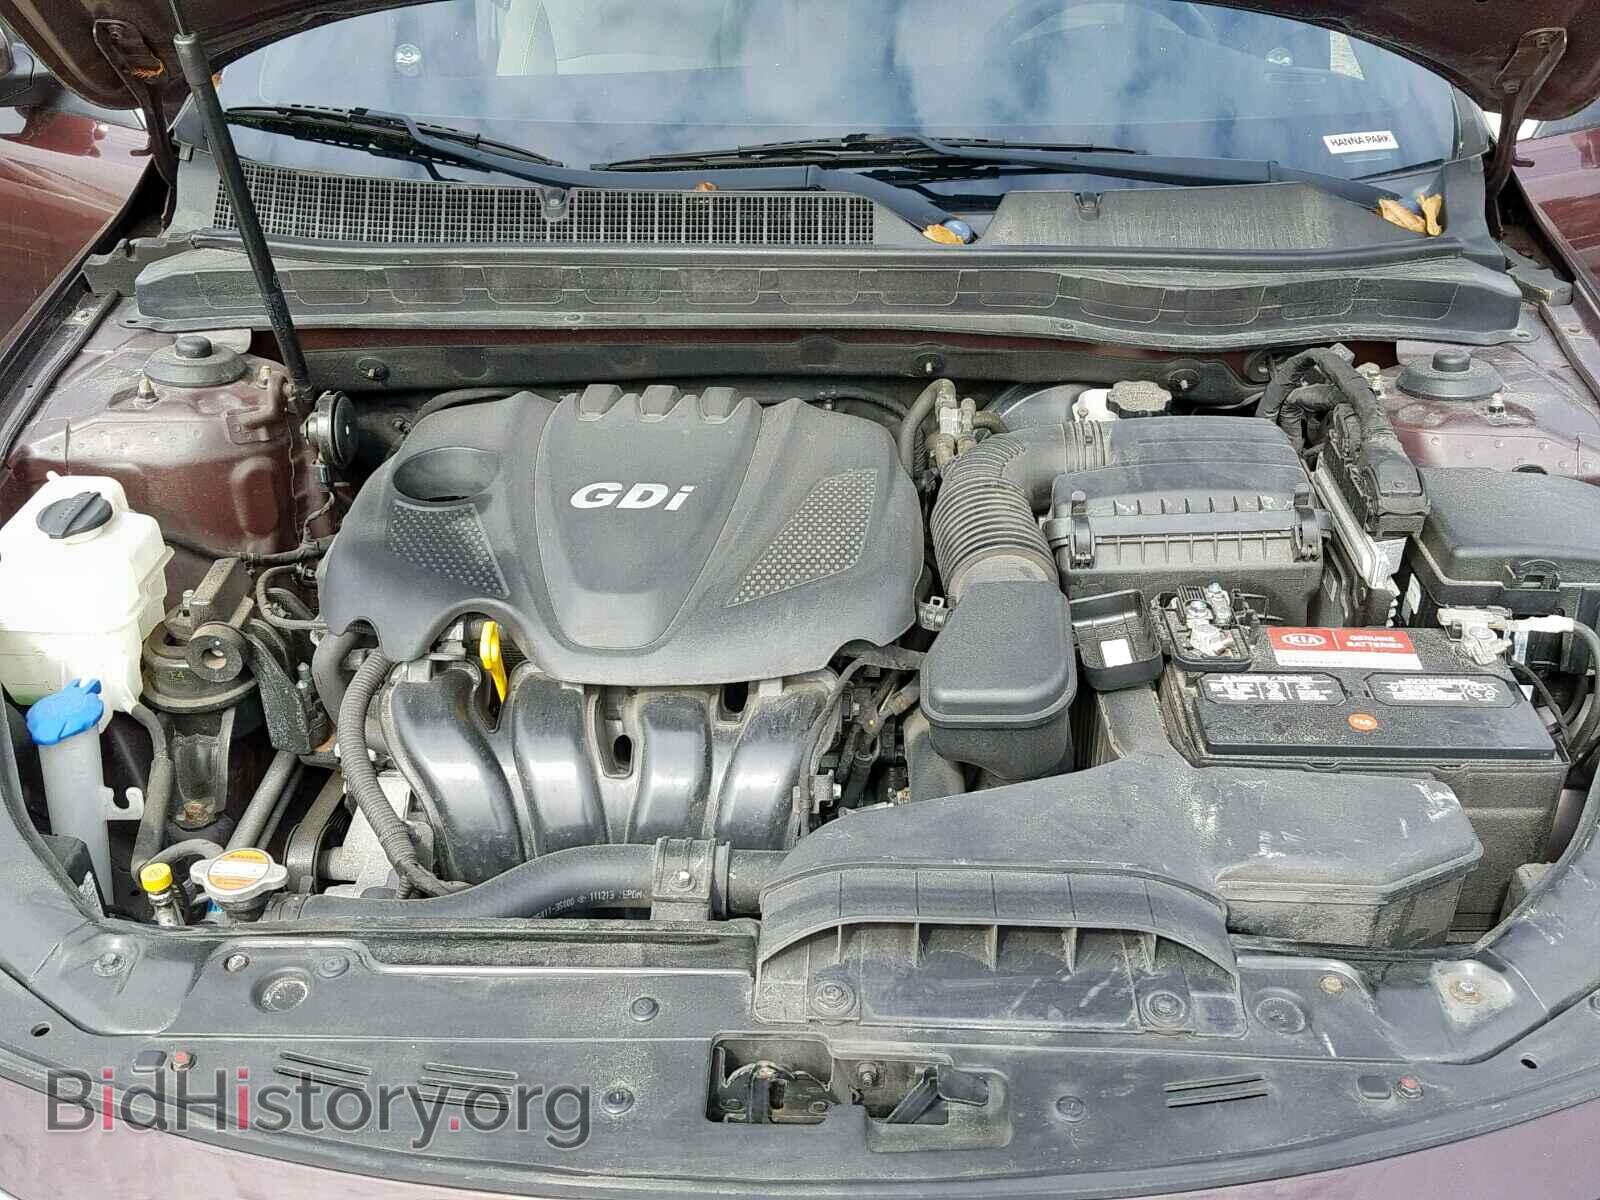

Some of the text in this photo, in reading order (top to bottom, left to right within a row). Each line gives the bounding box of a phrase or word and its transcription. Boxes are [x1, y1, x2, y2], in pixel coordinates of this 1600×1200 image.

[1330, 136, 1365, 147] HANNA
[570, 482, 696, 511] GDi
[1285, 634, 1322, 645] KIA
